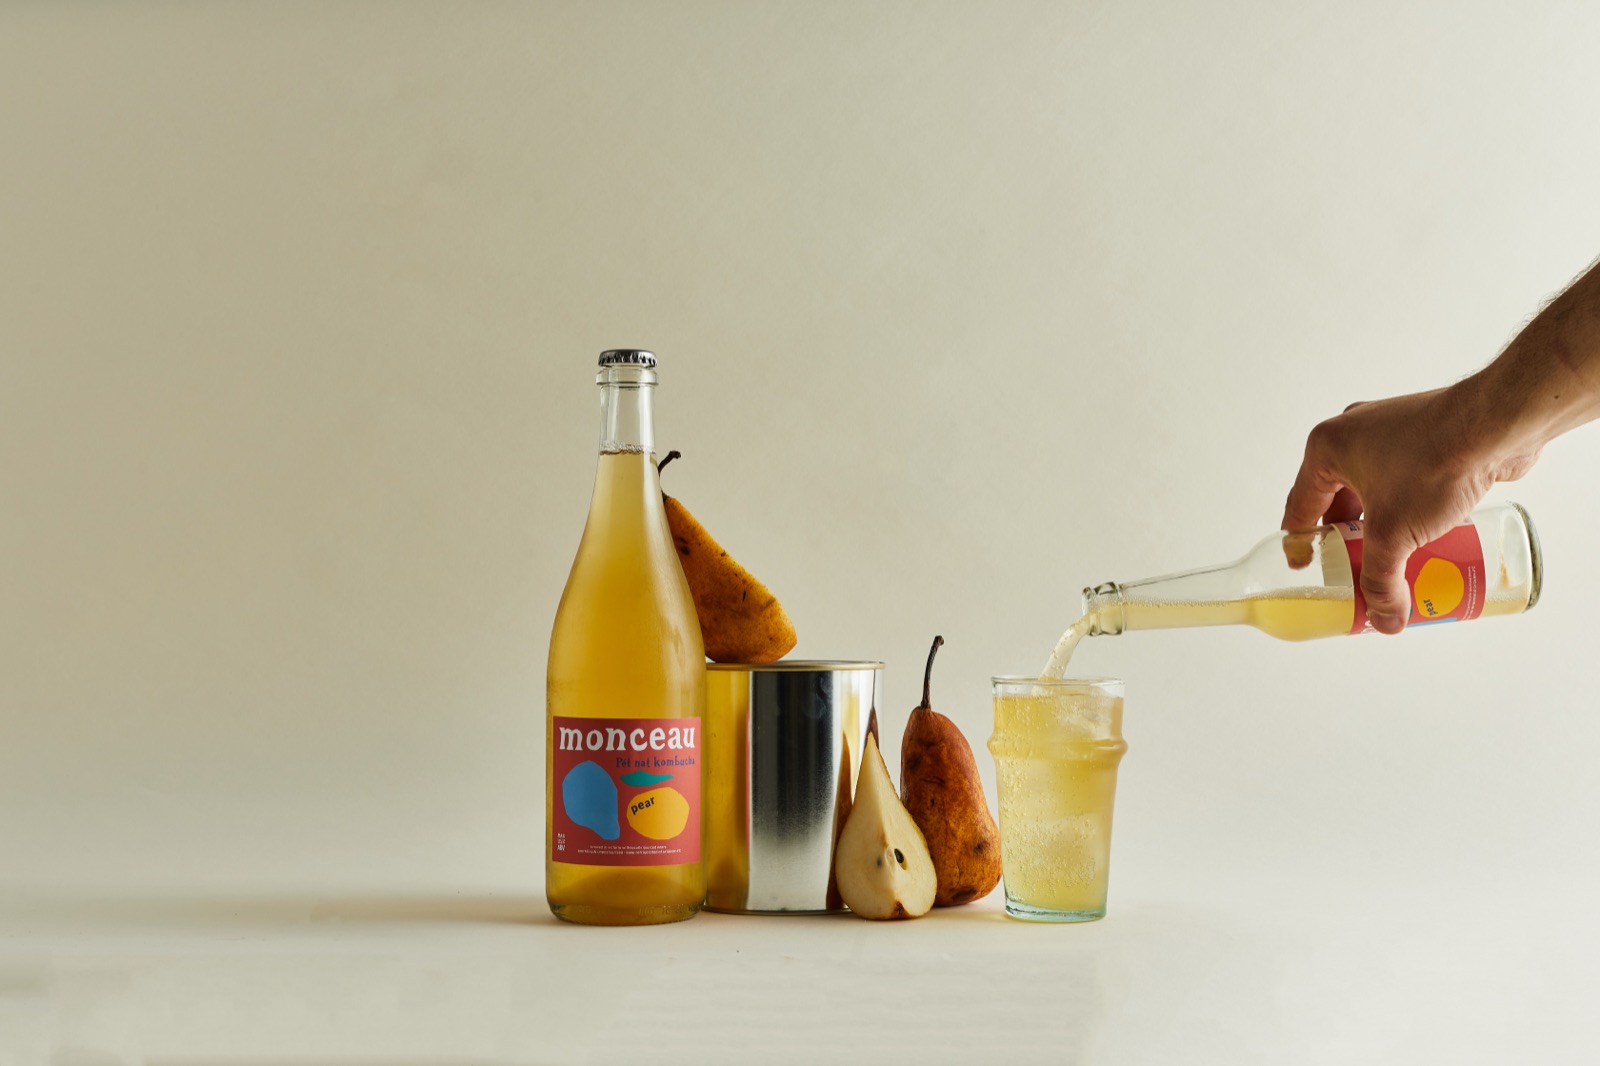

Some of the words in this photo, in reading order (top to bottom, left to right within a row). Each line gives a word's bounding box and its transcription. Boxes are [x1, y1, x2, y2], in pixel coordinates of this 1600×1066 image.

[1423, 599, 1439, 616] pear
[559, 727, 695, 751] monceau
[634, 758, 651, 768] nat
[654, 756, 695, 767] kombucha
[630, 796, 655, 815] pear
